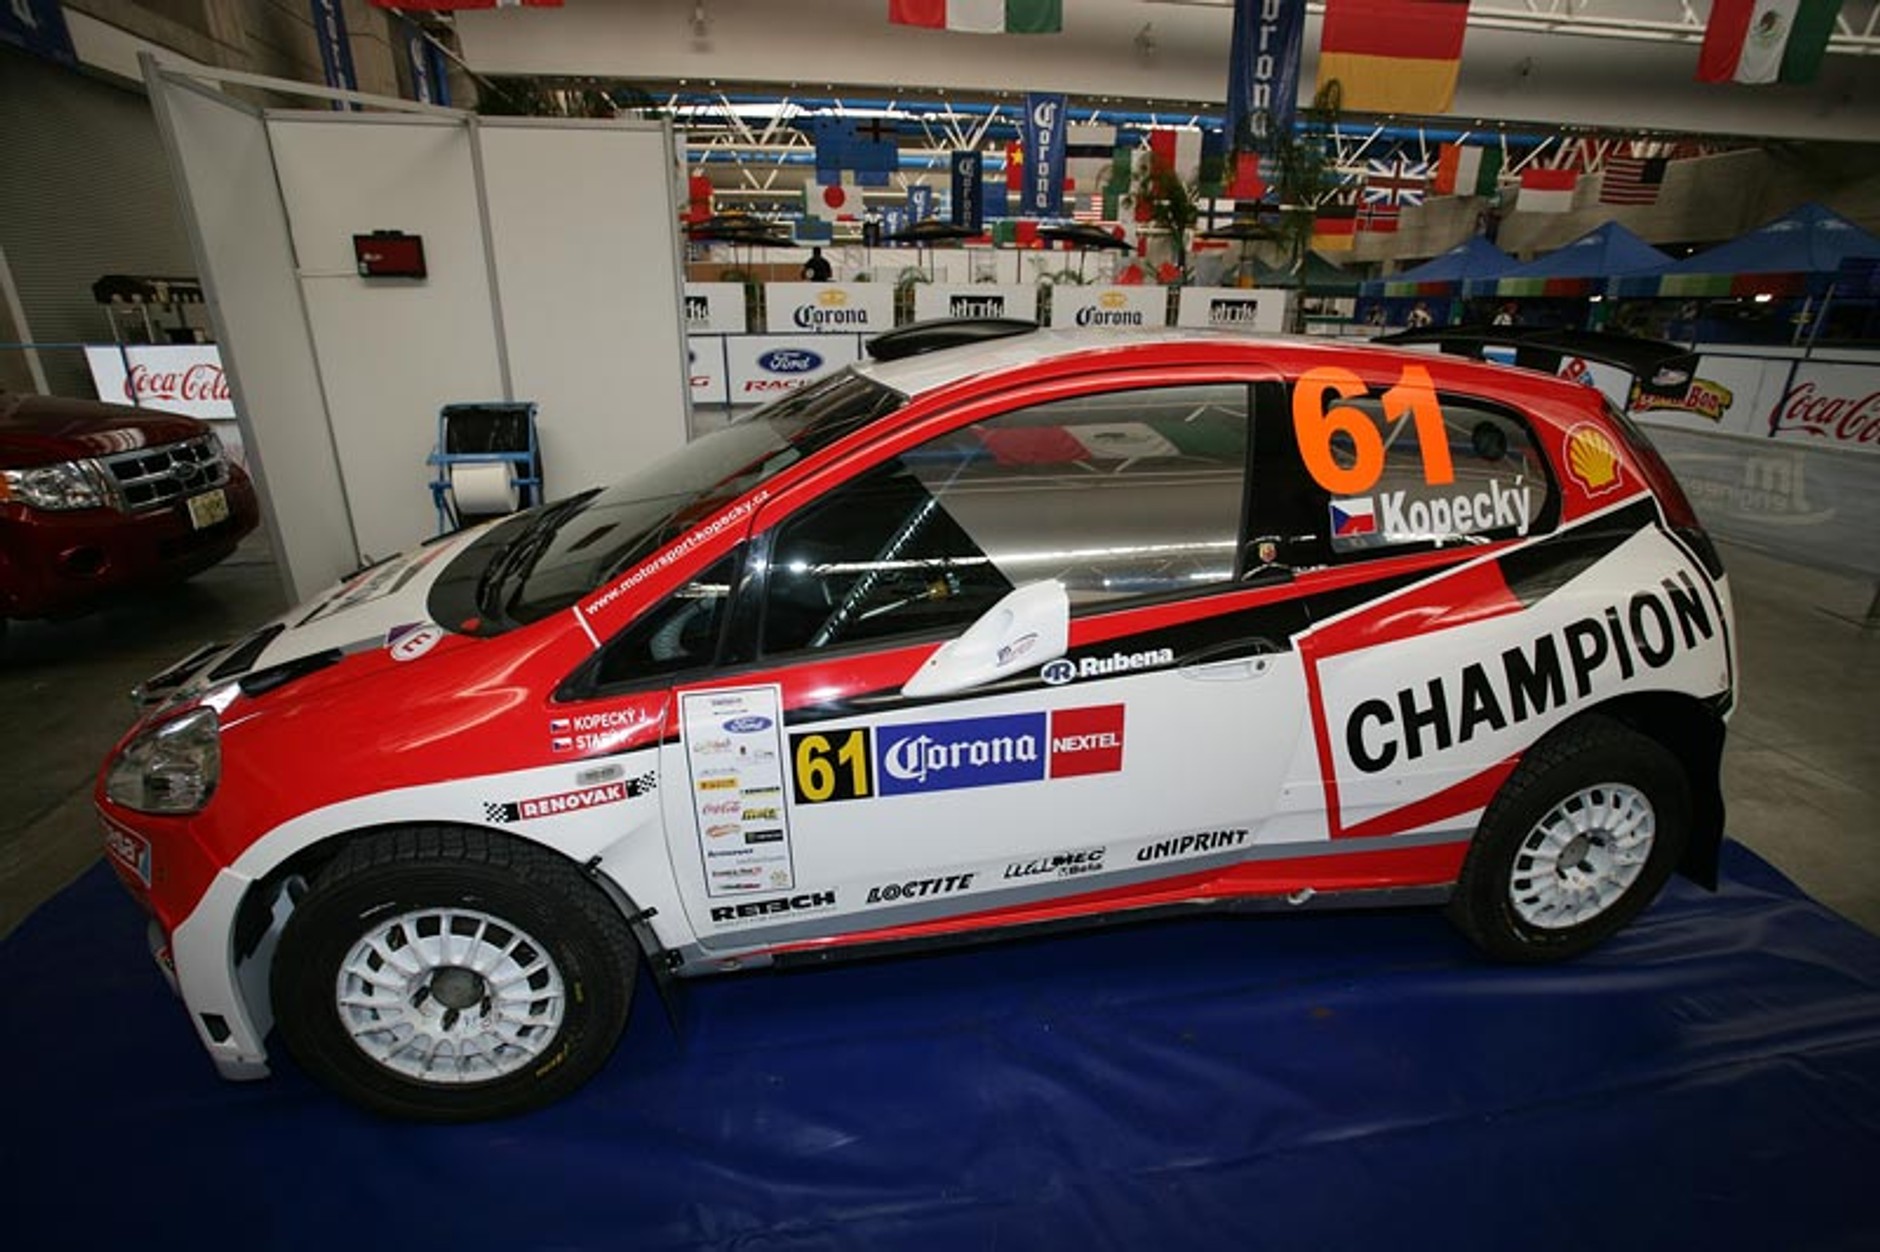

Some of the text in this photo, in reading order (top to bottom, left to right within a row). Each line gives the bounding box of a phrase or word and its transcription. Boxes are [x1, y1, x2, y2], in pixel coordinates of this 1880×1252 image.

[1033, 101, 1057, 208] Corona
[793, 304, 869, 328] Corona
[1075, 306, 1143, 326] Corona
[1293, 364, 1455, 496] 61
[1380, 475, 1531, 548] Kopecký
[1079, 648, 1174, 677] Rubena
[796, 729, 1120, 801] 61 Corona NEXTEL
[524, 785, 622, 817] RENOVAK
[1137, 830, 1248, 861] UNIPRINT
[866, 873, 974, 904] LOCTITE
